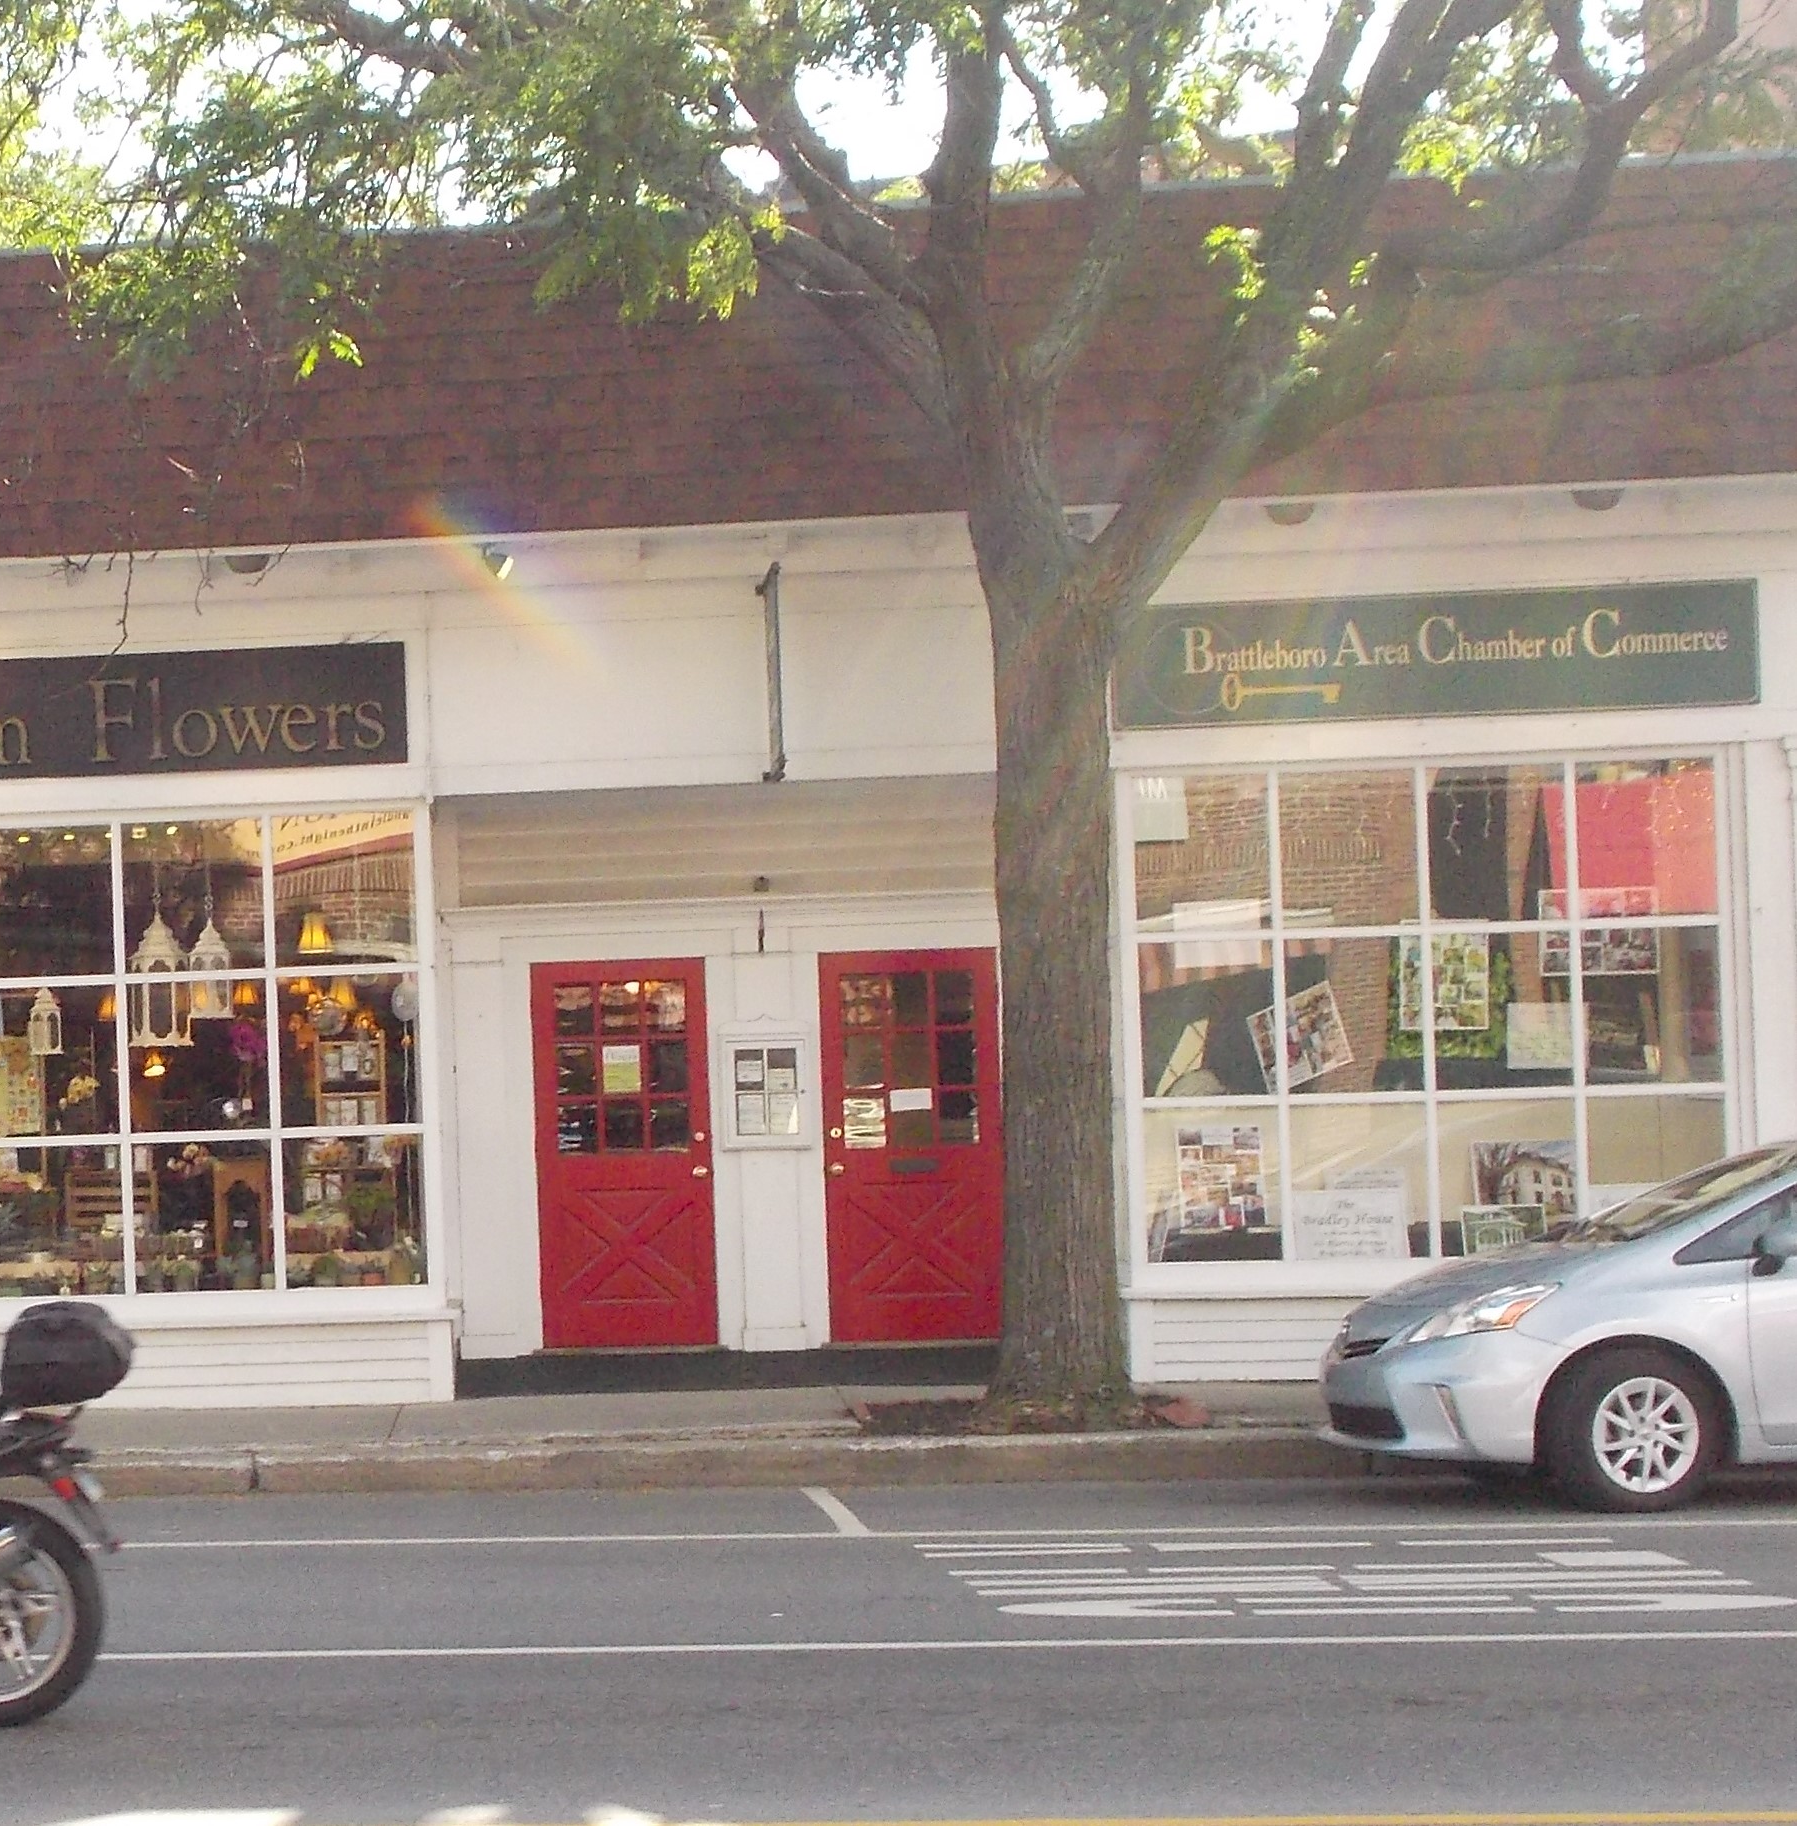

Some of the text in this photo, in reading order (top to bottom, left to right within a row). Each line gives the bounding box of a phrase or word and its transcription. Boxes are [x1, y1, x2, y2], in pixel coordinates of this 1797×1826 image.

[1182, 607, 1729, 674] Brattleboro Area Chamber of Commerce
[88, 676, 387, 762] Flowers
